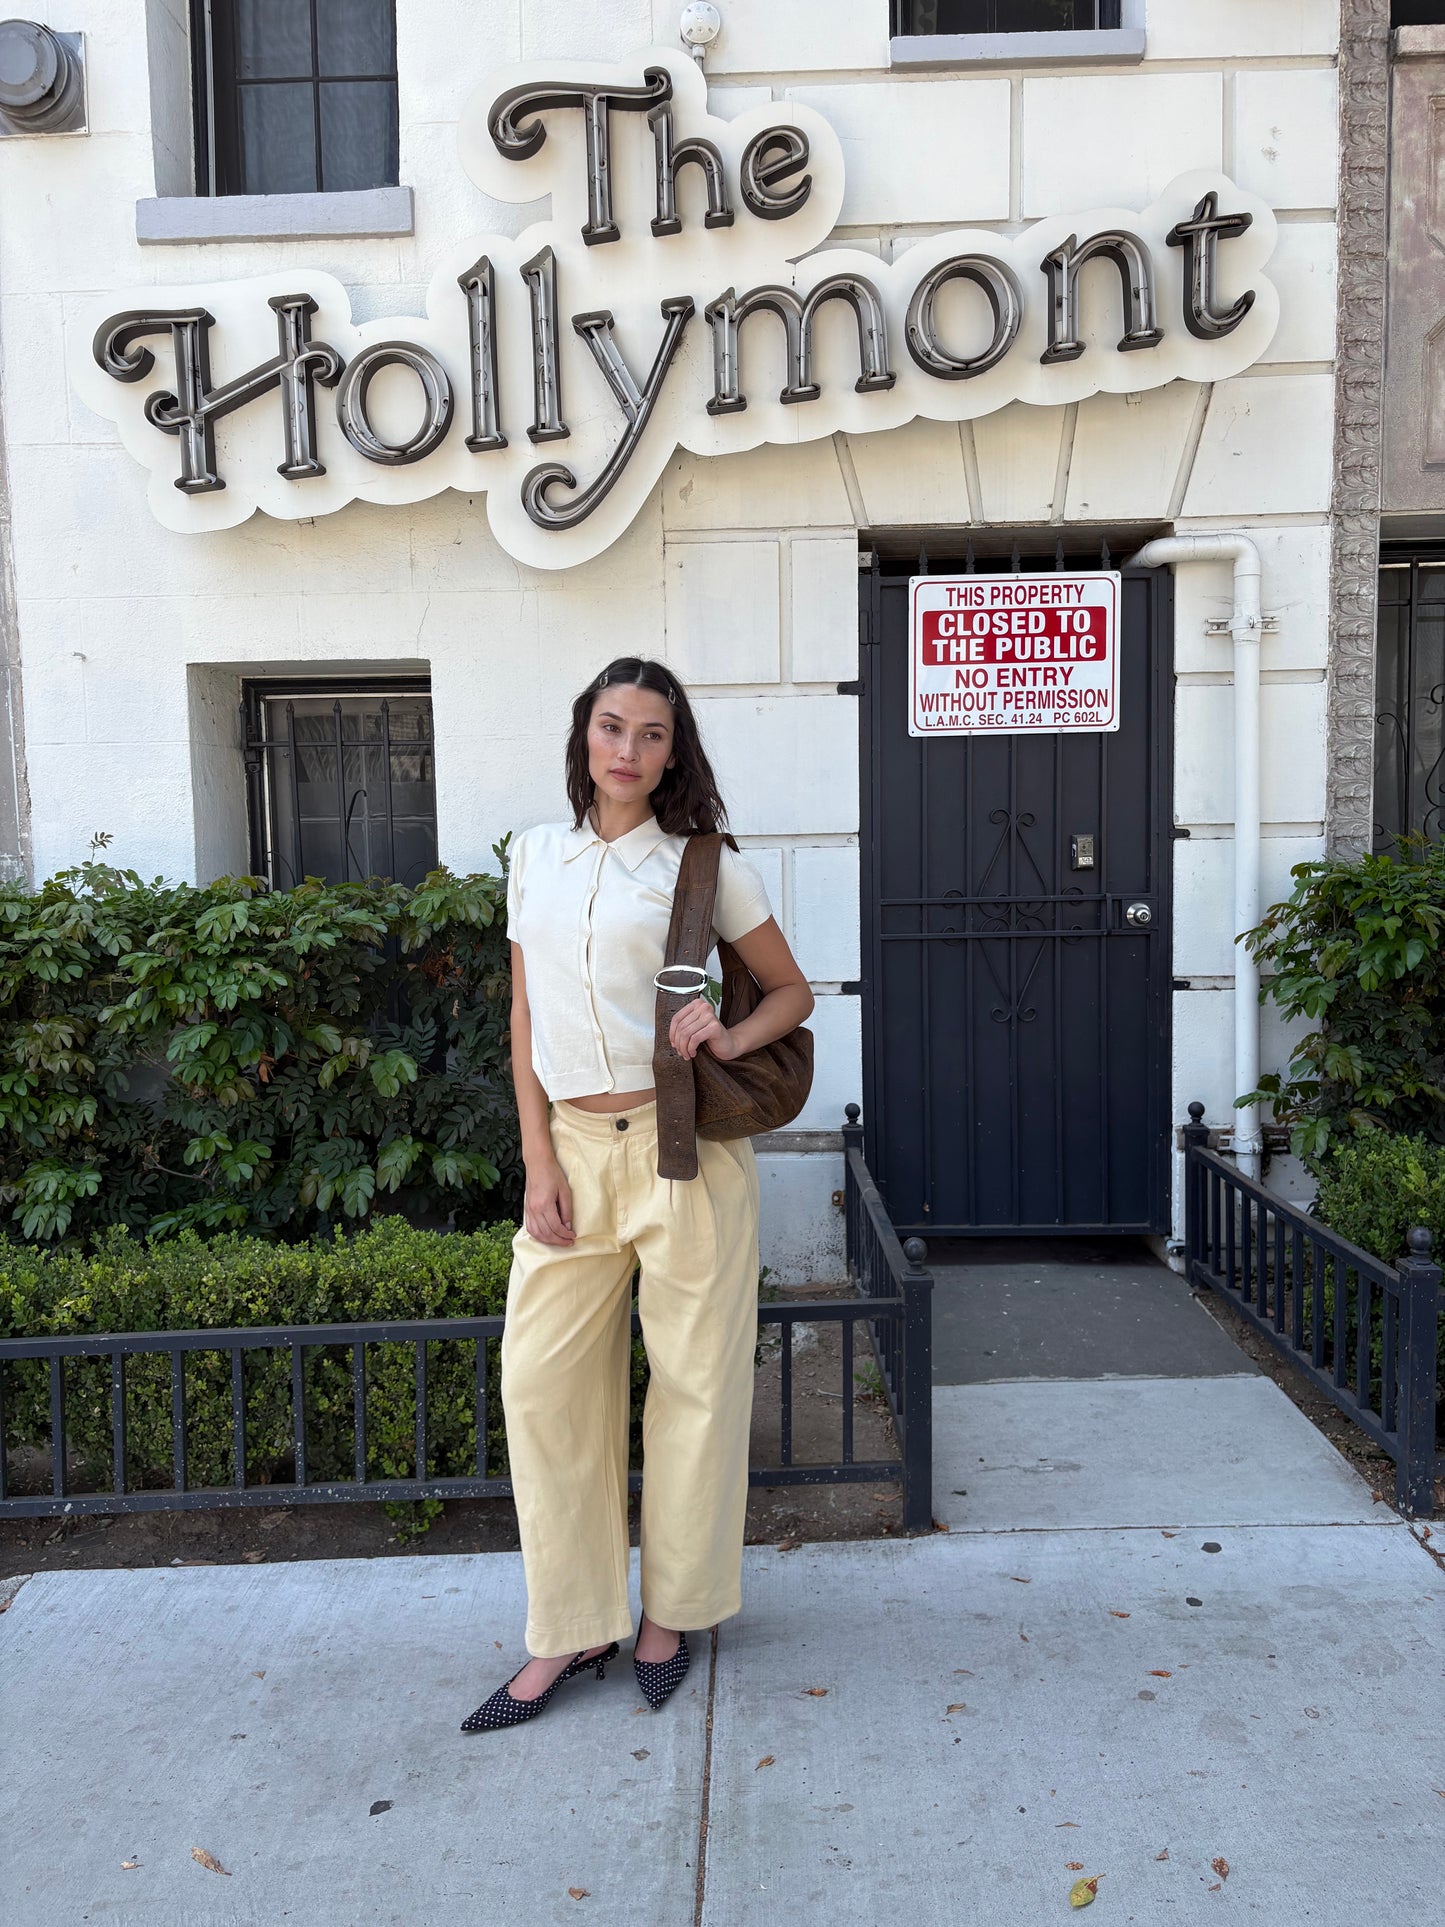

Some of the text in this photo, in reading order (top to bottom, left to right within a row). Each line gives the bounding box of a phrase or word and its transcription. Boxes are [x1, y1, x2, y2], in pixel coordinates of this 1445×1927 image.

[488, 66, 812, 246] The
[93, 190, 1256, 531] Hollymont
[946, 584, 1085, 607] THIS PROPERTY
[938, 609, 1091, 637] CLOSED TO
[932, 635, 1096, 662] THE PUBLIC
[955, 666, 1074, 689] NO ENTRY
[919, 688, 1108, 713] WITHOUT PERMISSION
[925, 711, 1103, 727] L.A.M.C. SEC. 41.24 PC 602L
